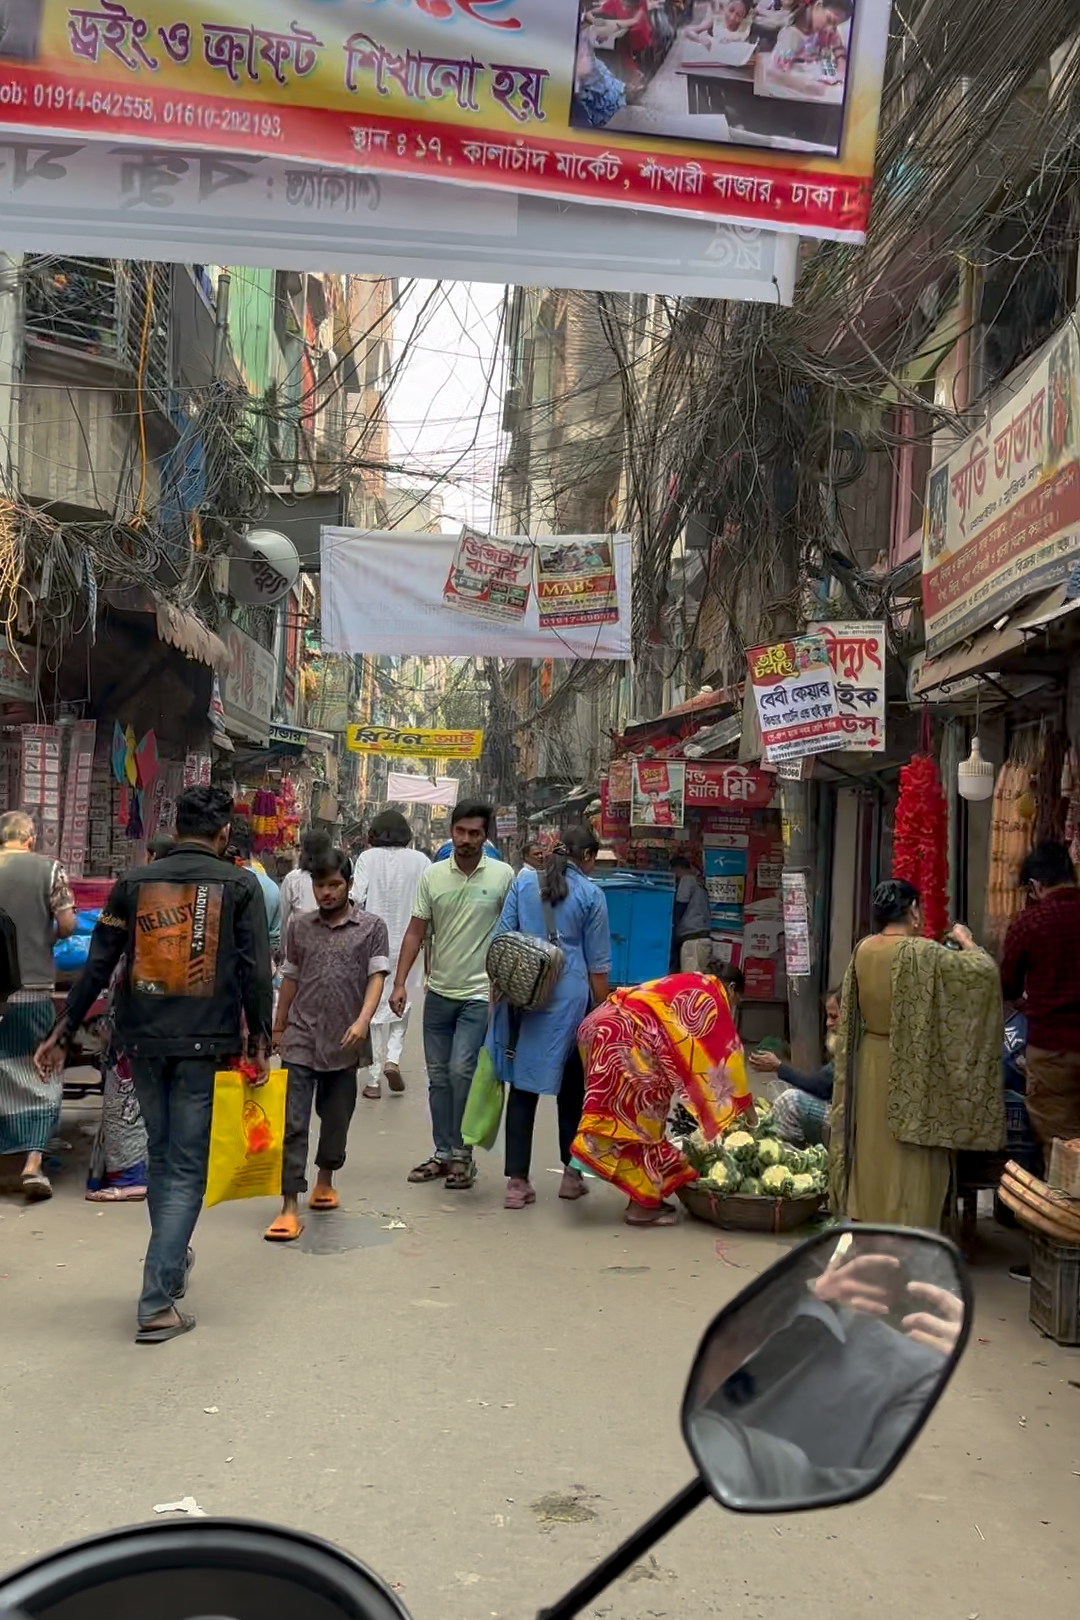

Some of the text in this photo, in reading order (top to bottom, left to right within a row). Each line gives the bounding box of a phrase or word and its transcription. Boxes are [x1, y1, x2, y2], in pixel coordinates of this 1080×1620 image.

[158, 22, 190, 62] ও
[488, 63, 550, 121] হয়
[0, 81, 28, 105] ob:
[542, 580, 594, 597] MABS
[193, 885, 209, 940] RADIATION
